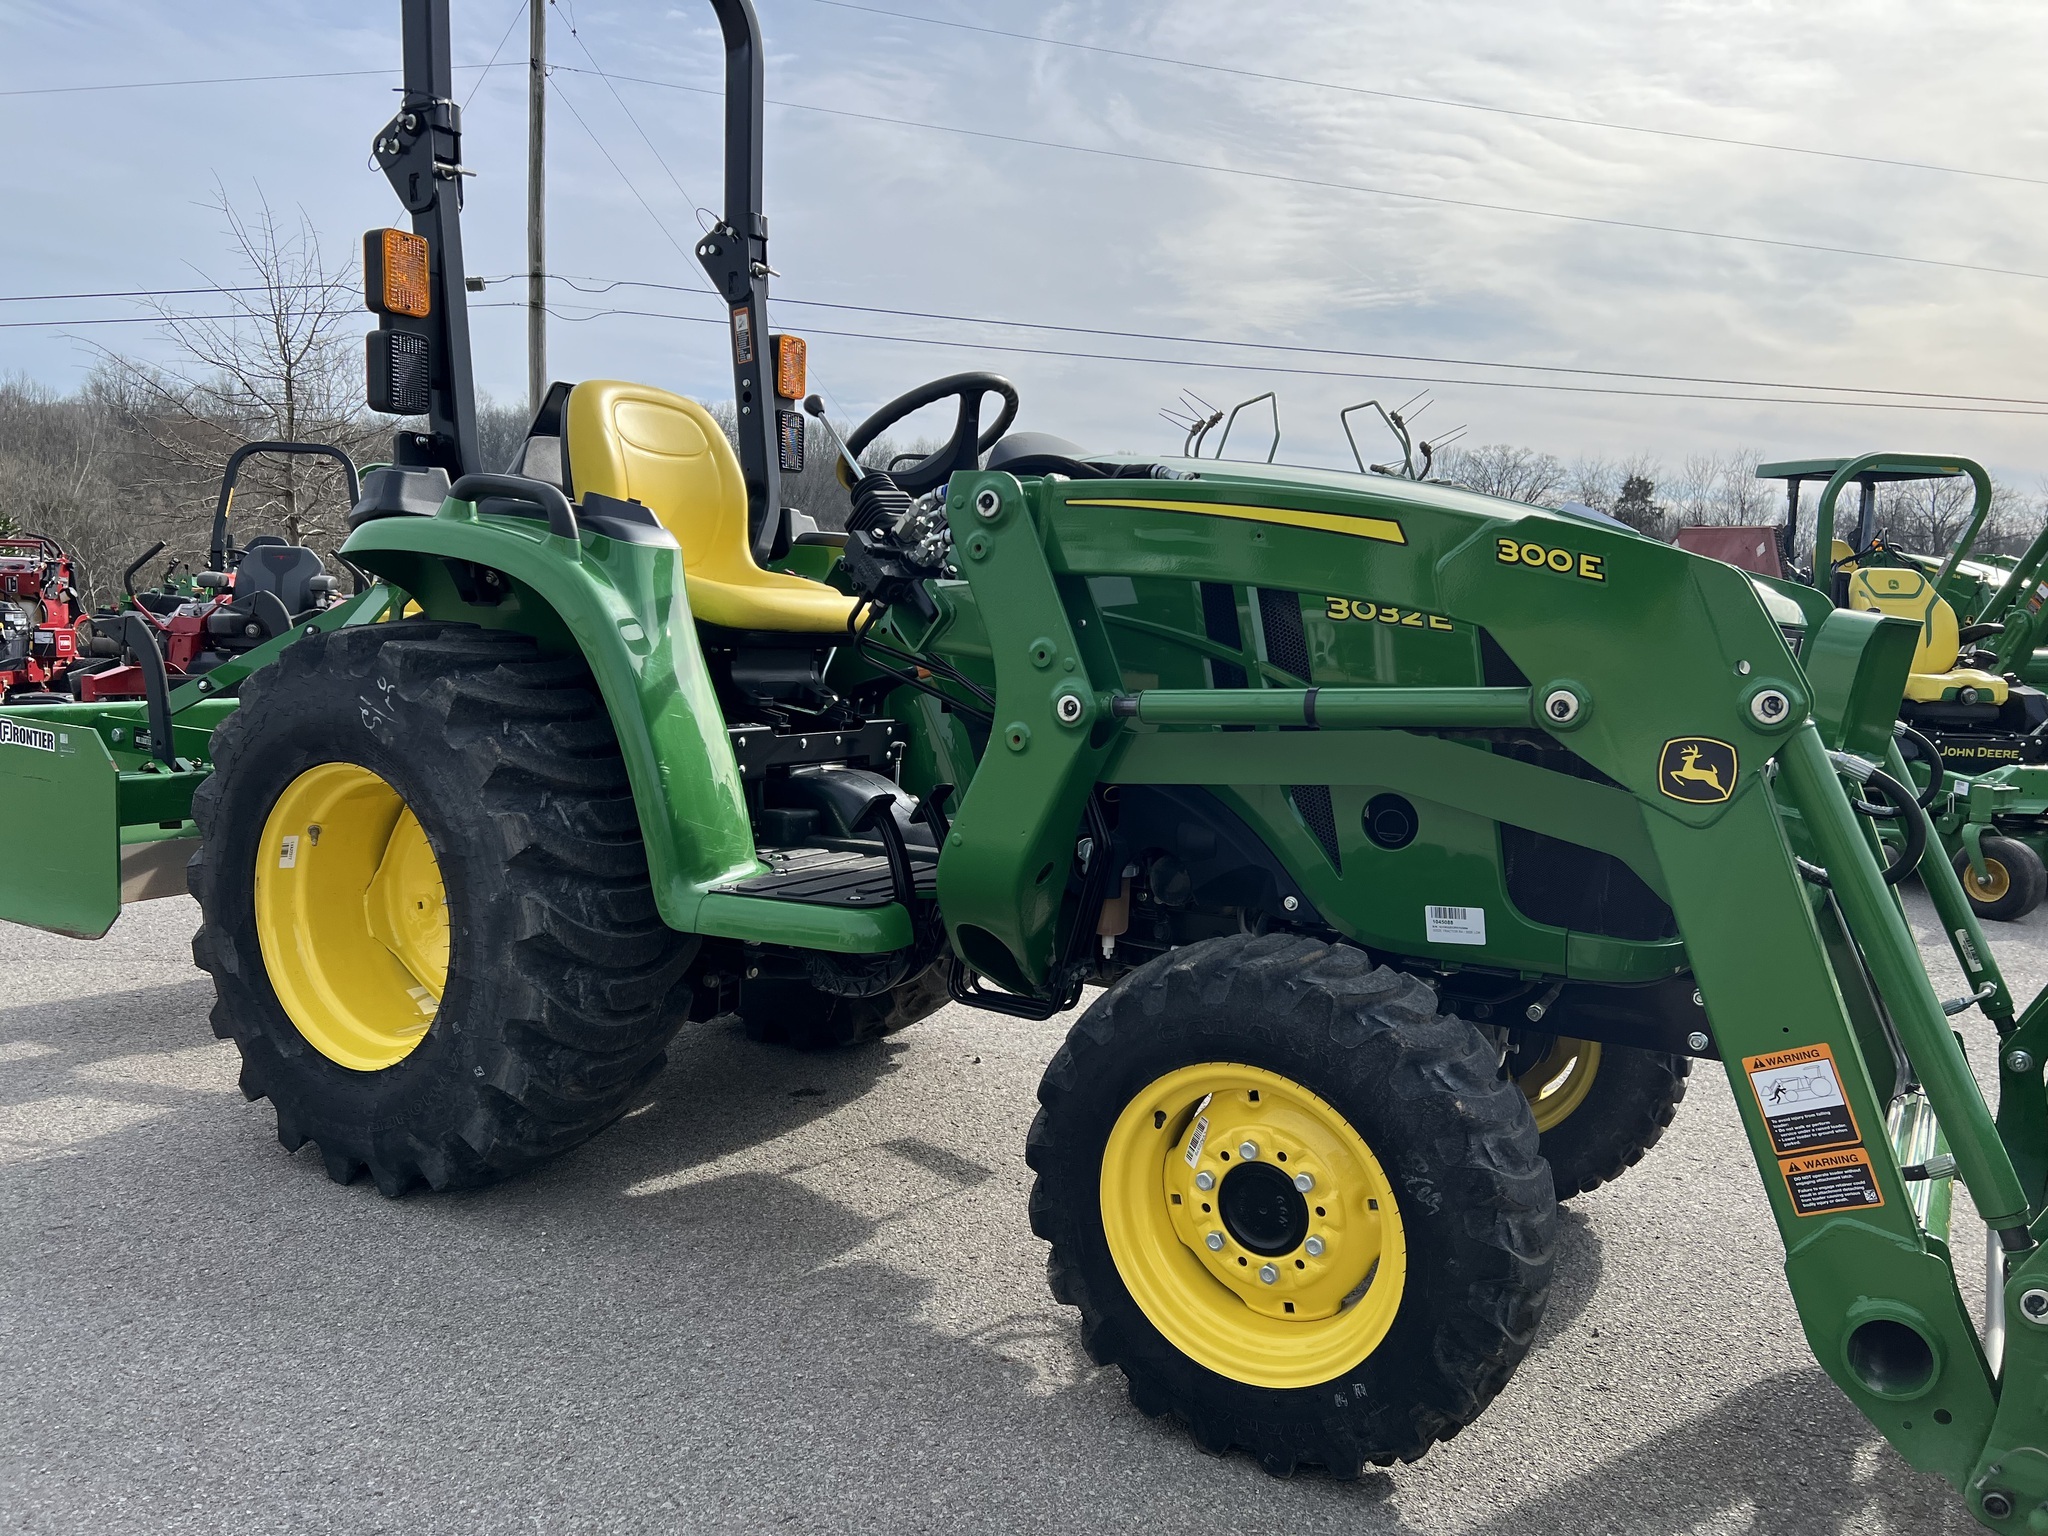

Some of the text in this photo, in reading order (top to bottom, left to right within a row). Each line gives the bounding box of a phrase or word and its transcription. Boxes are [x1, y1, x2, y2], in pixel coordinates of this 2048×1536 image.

[1498, 539, 1604, 581] 300E
[1, 721, 54, 750] FRONTIER
[1765, 1049, 1820, 1066] WARNING
[1804, 1154, 1859, 1168] WARNING
